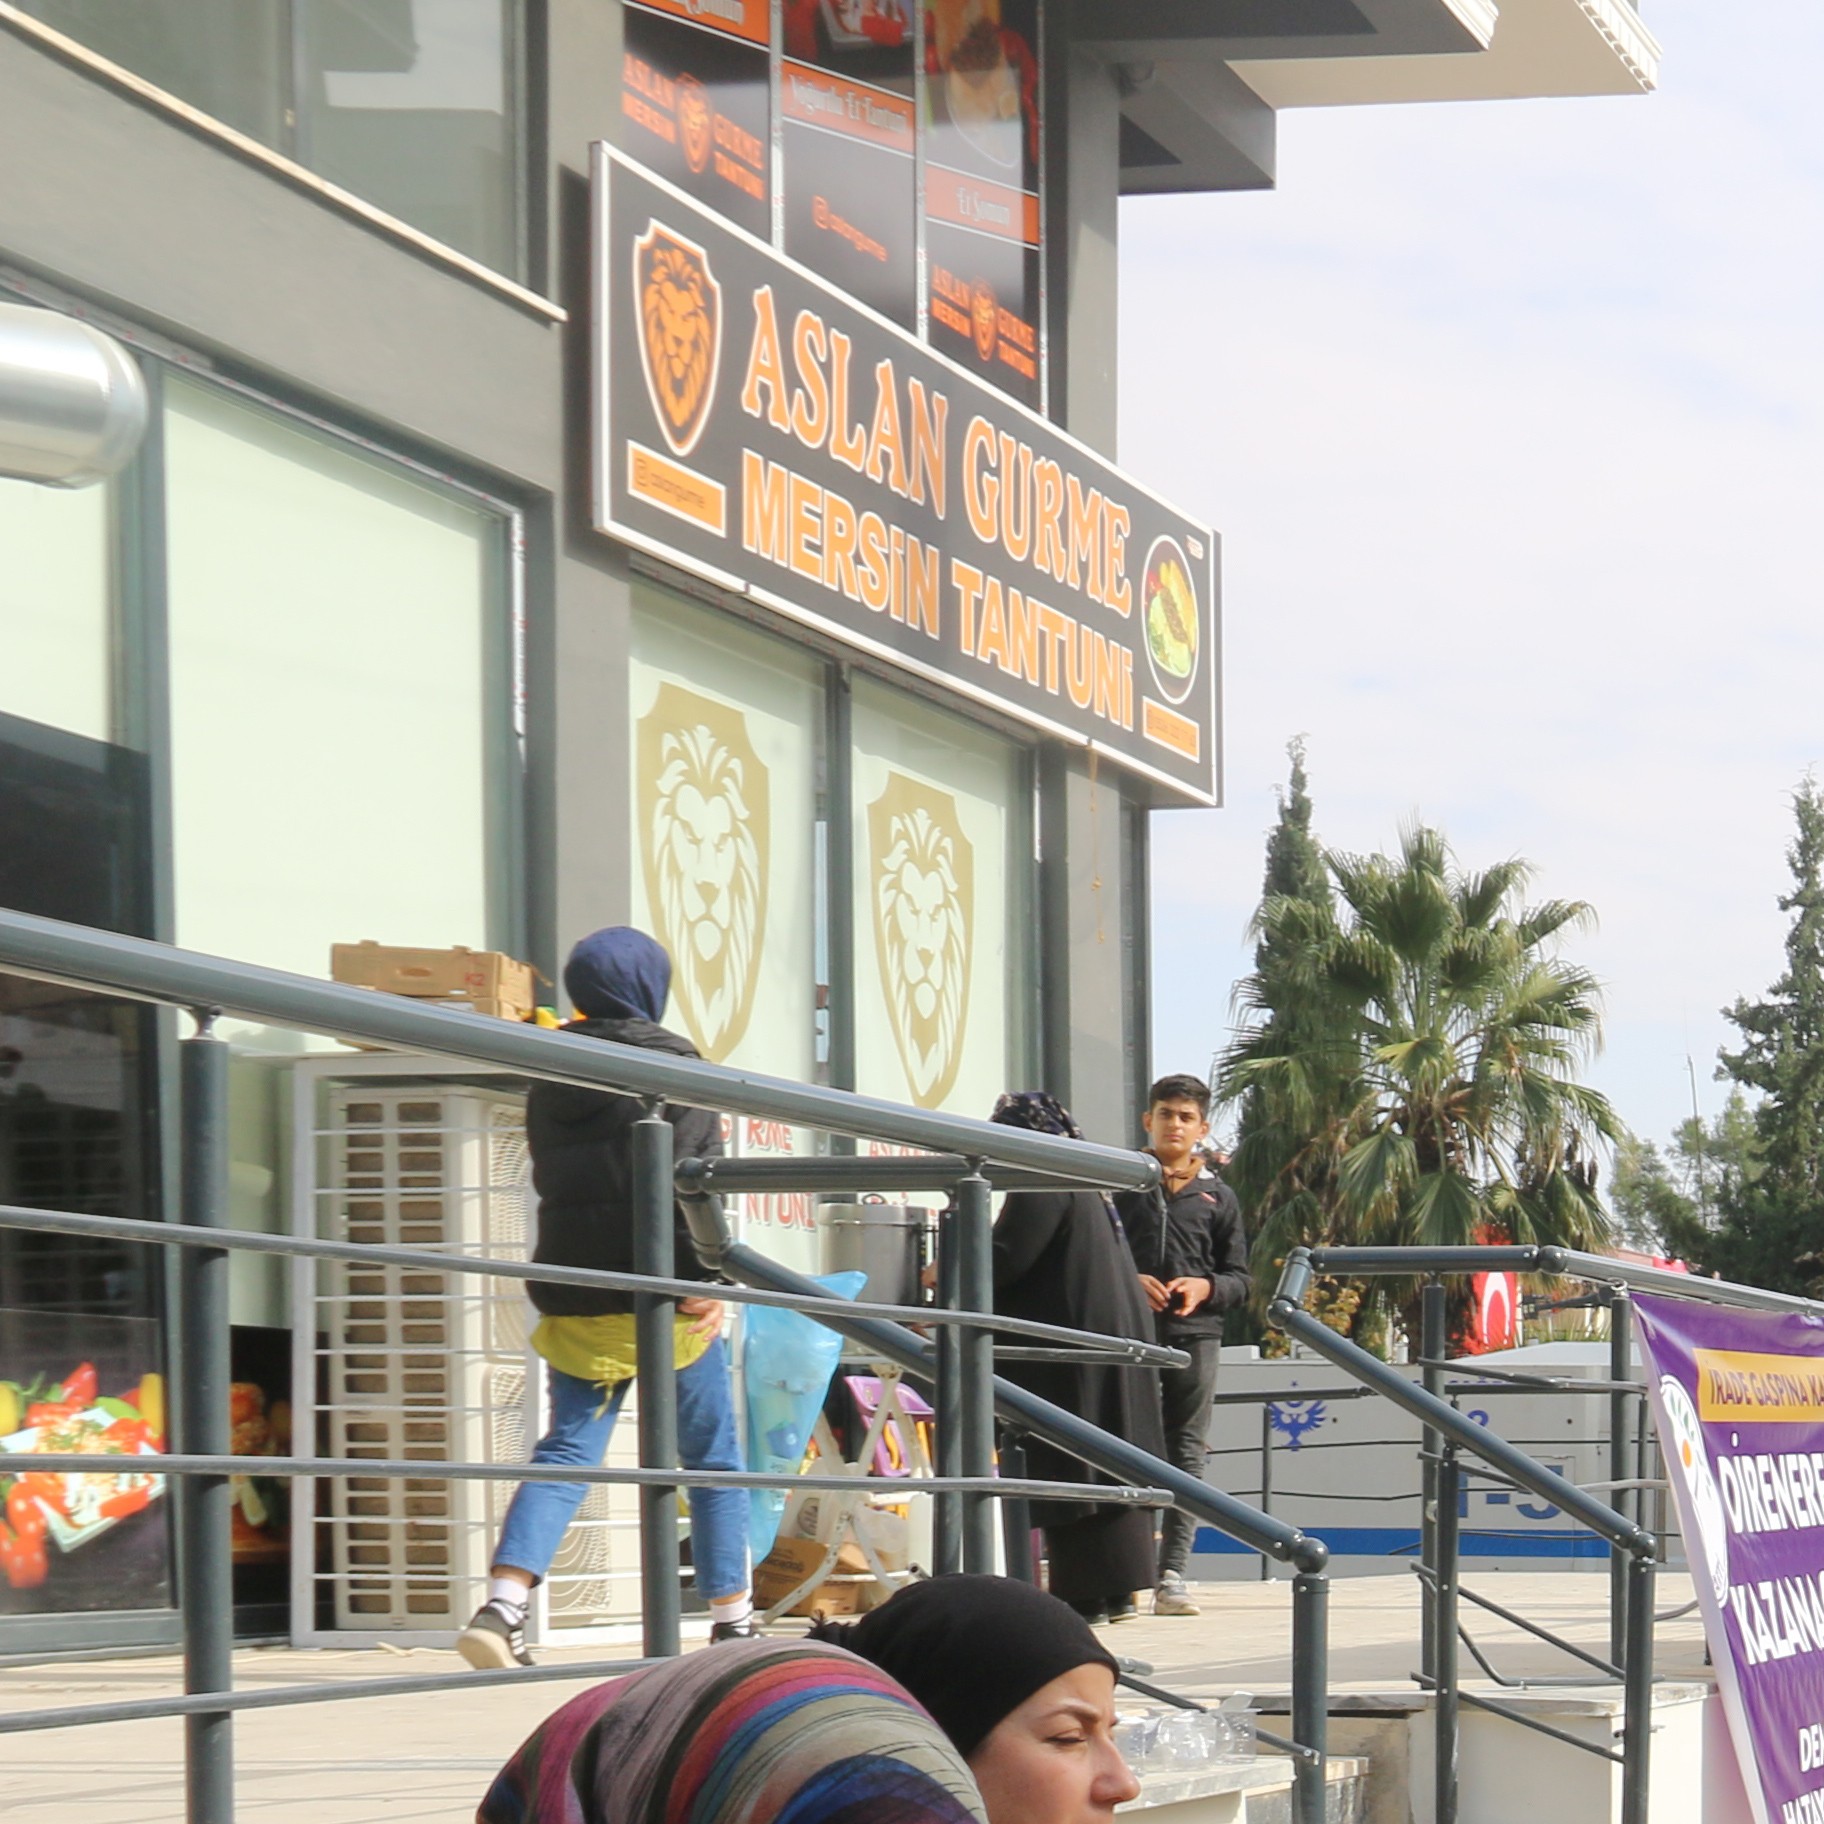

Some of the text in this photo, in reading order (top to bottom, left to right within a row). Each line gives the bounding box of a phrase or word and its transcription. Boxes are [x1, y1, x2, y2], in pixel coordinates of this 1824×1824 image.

[742, 285, 1132, 618] ASLAN GURME
[742, 448, 1133, 731] MERSİN TANTUNİ
